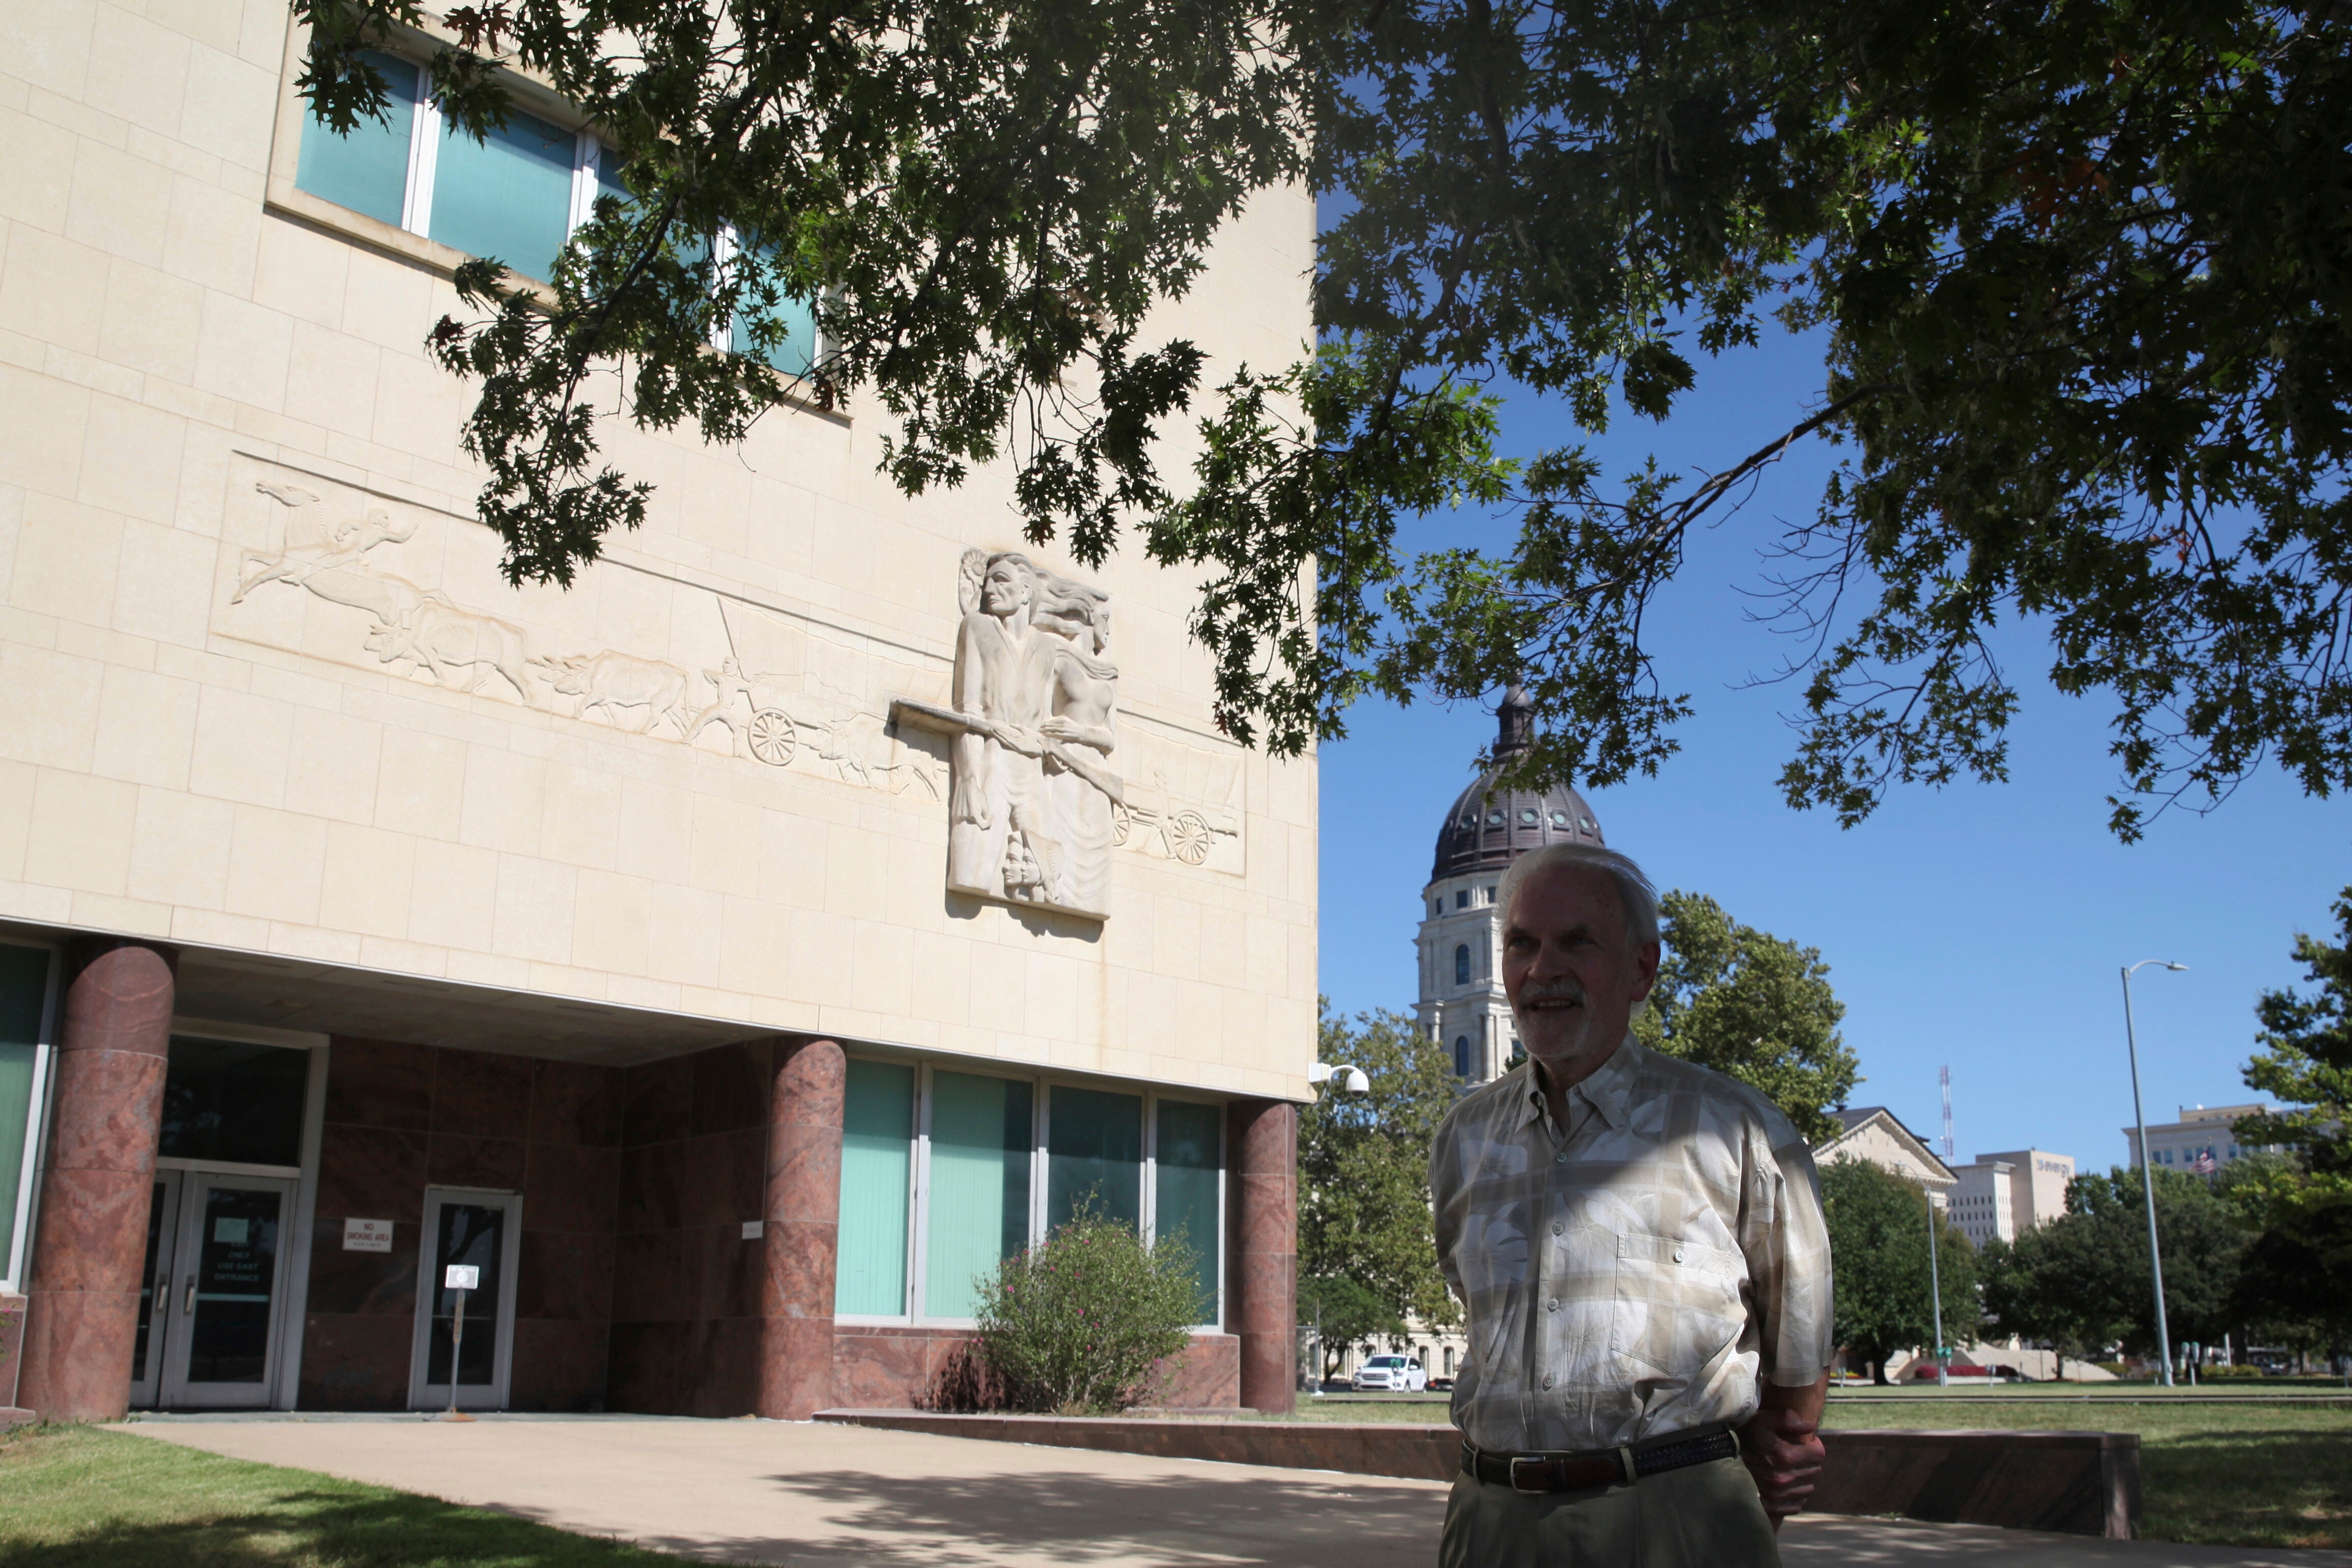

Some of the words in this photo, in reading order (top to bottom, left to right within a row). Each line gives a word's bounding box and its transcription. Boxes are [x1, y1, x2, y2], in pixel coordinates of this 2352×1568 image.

[2045, 1161, 2070, 1179] evergy
[347, 1232, 373, 1240] SMOKING
[375, 1234, 389, 1242] AREA
